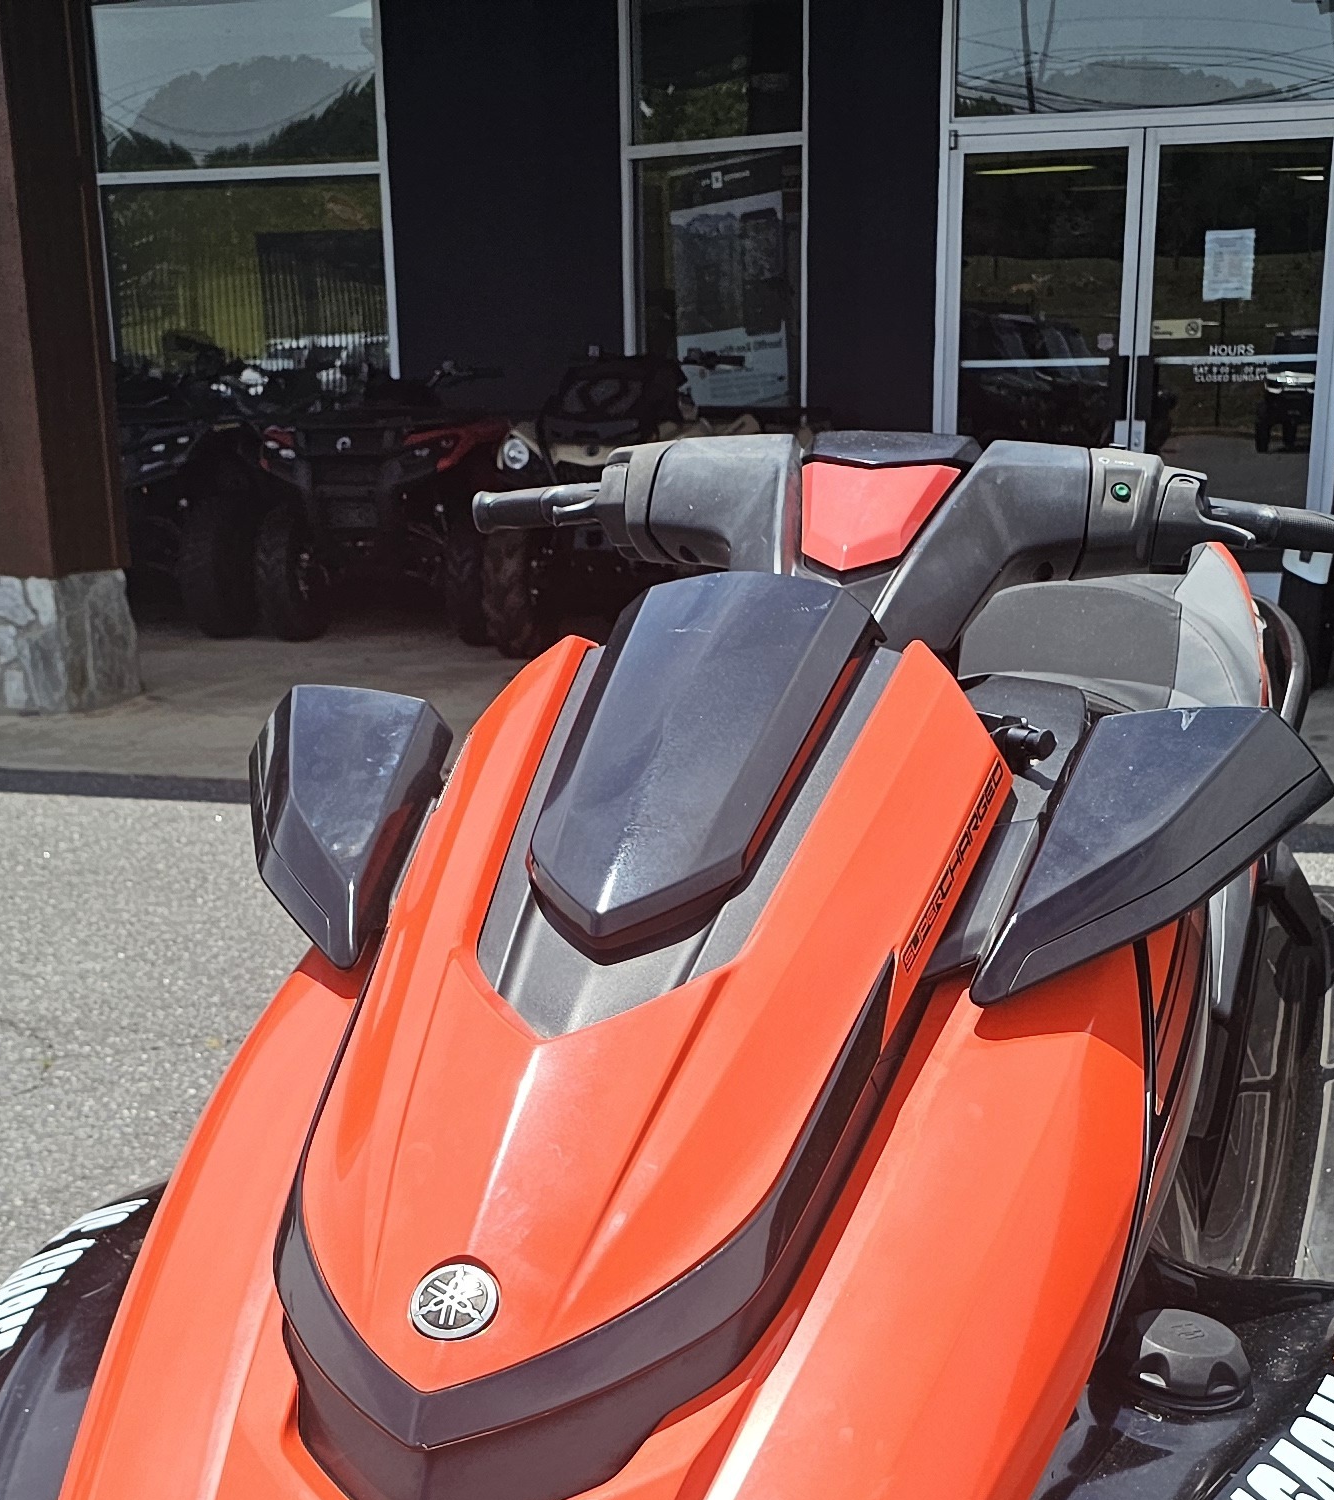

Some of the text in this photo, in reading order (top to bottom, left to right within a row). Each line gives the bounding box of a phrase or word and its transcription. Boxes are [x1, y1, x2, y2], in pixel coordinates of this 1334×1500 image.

[1209, 344, 1255, 356] HOURS
[1194, 373, 1265, 382] CLOSED SUNDAY
[901, 759, 1004, 974] SUPERCHARGED
